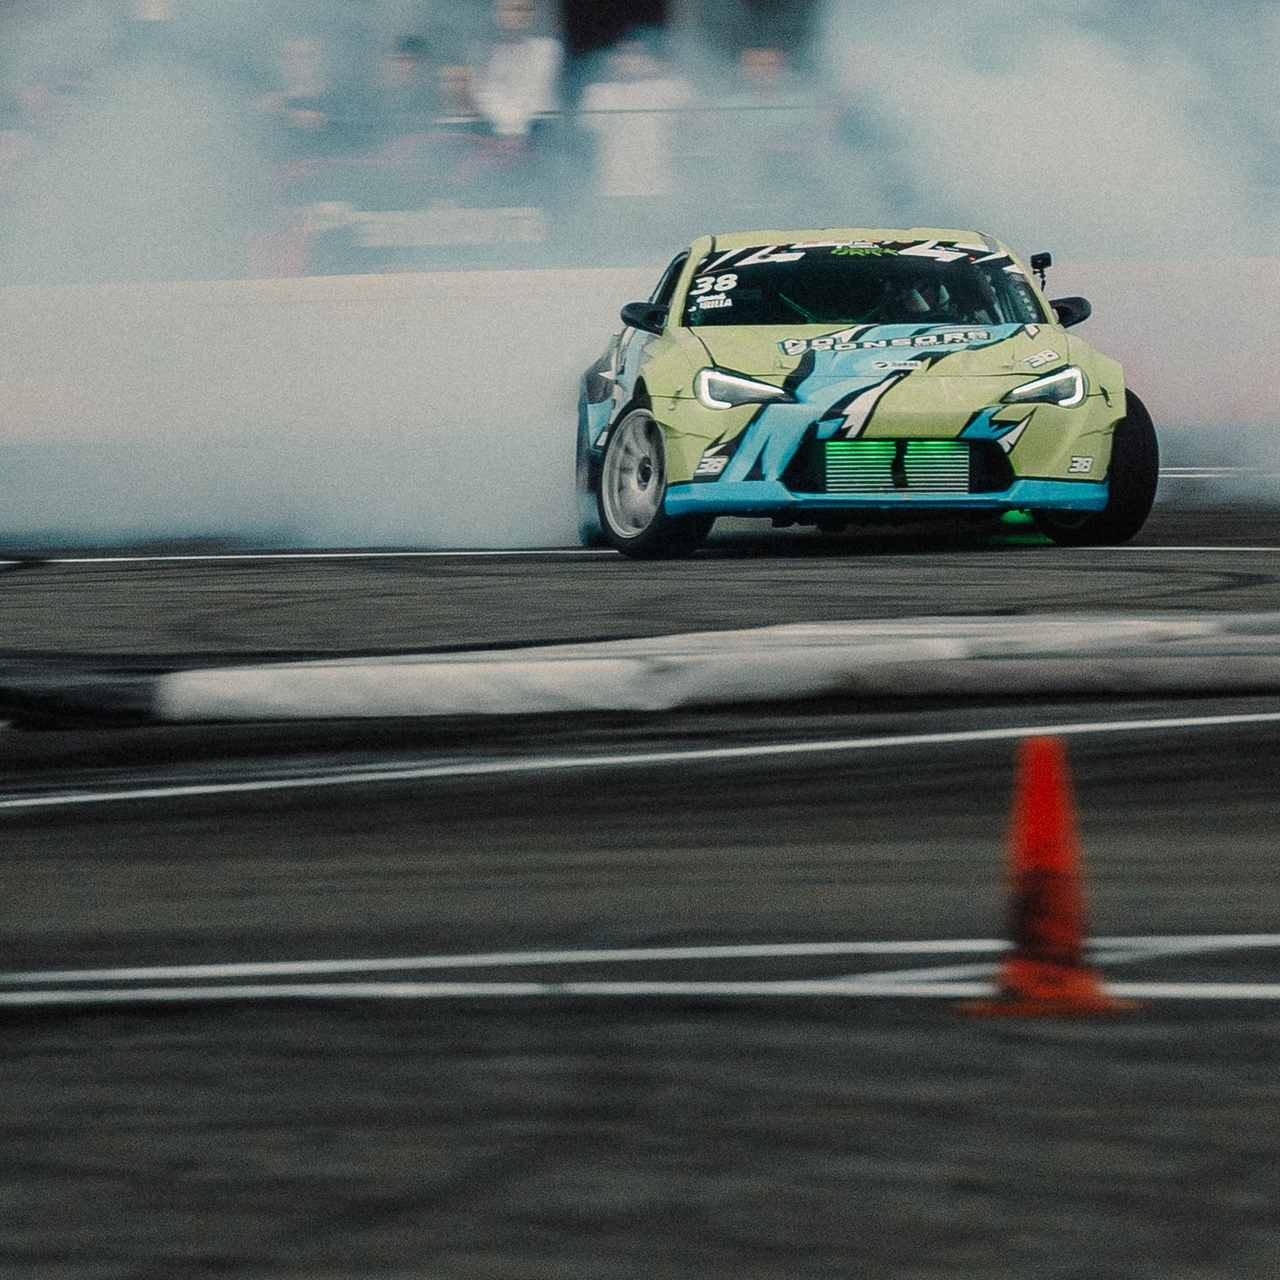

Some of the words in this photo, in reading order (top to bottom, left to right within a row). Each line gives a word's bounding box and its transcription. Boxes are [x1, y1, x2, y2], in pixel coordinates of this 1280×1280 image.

[690, 274, 738, 295] 38
[1021, 349, 1060, 369] 38
[695, 457, 729, 474] 38
[1067, 456, 1094, 473] 38
